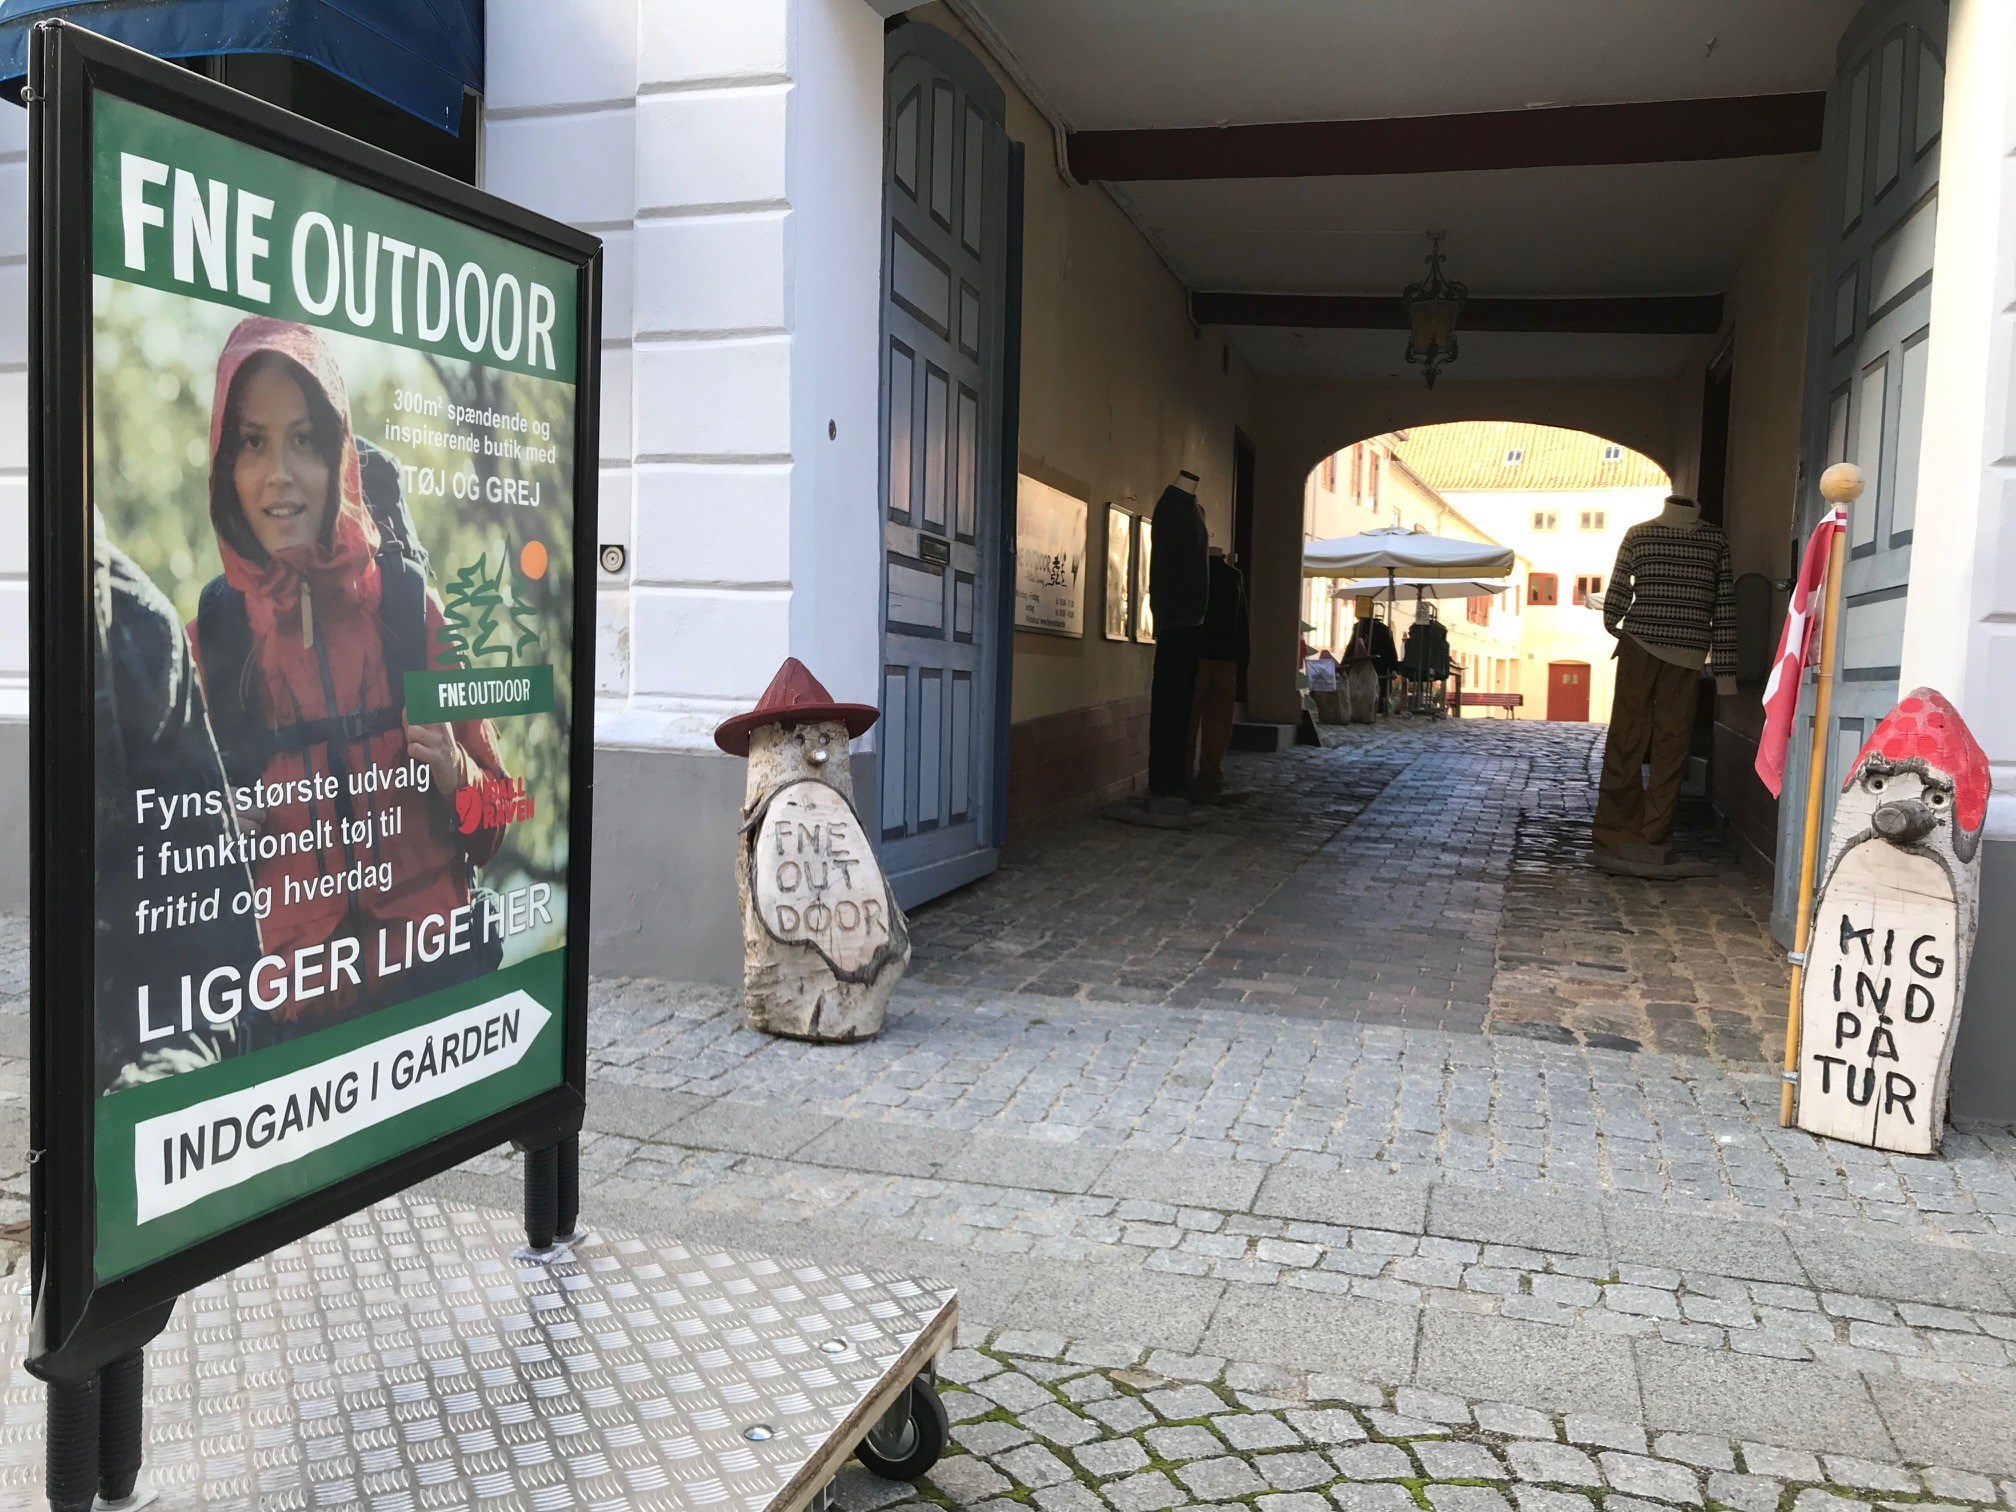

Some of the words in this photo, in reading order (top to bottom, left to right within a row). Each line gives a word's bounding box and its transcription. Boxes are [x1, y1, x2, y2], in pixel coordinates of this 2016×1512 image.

[120, 152, 275, 303] FNE
[291, 211, 557, 371] OUTDOOR
[385, 419, 480, 454] inspirerende
[484, 435, 522, 460] butik
[526, 446, 556, 464] med
[447, 404, 528, 433] spændende
[532, 420, 550, 441] og
[402, 465, 446, 497] TØJ
[452, 472, 480, 501] OG
[486, 476, 541, 507] GREJ
[438, 682, 467, 708] FNE
[468, 679, 531, 706] OUTDOOR
[136, 788, 223, 830] Fyns
[235, 772, 339, 812] største
[348, 758, 431, 796] udvalg
[137, 846, 145, 880] i
[158, 819, 333, 876] funktionelt
[341, 810, 373, 850] tøj
[380, 806, 402, 838] til
[775, 820, 850, 858] FNE
[135, 888, 220, 935] fritid
[232, 885, 272, 919] og
[284, 860, 392, 905] hverdag
[776, 859, 860, 894] OUT
[776, 898, 888, 937] DOOR
[1839, 914, 1945, 979] KIG
[138, 936, 362, 1043] LIGGER
[378, 905, 472, 978] LIGE
[483, 882, 552, 944] HER
[1833, 964, 1935, 1024] IND
[163, 1071, 359, 1185] INDGANG
[370, 1061, 380, 1102] I
[391, 1008, 521, 1091] GÅRDEN
[1813, 1054, 1917, 1126] TUR
